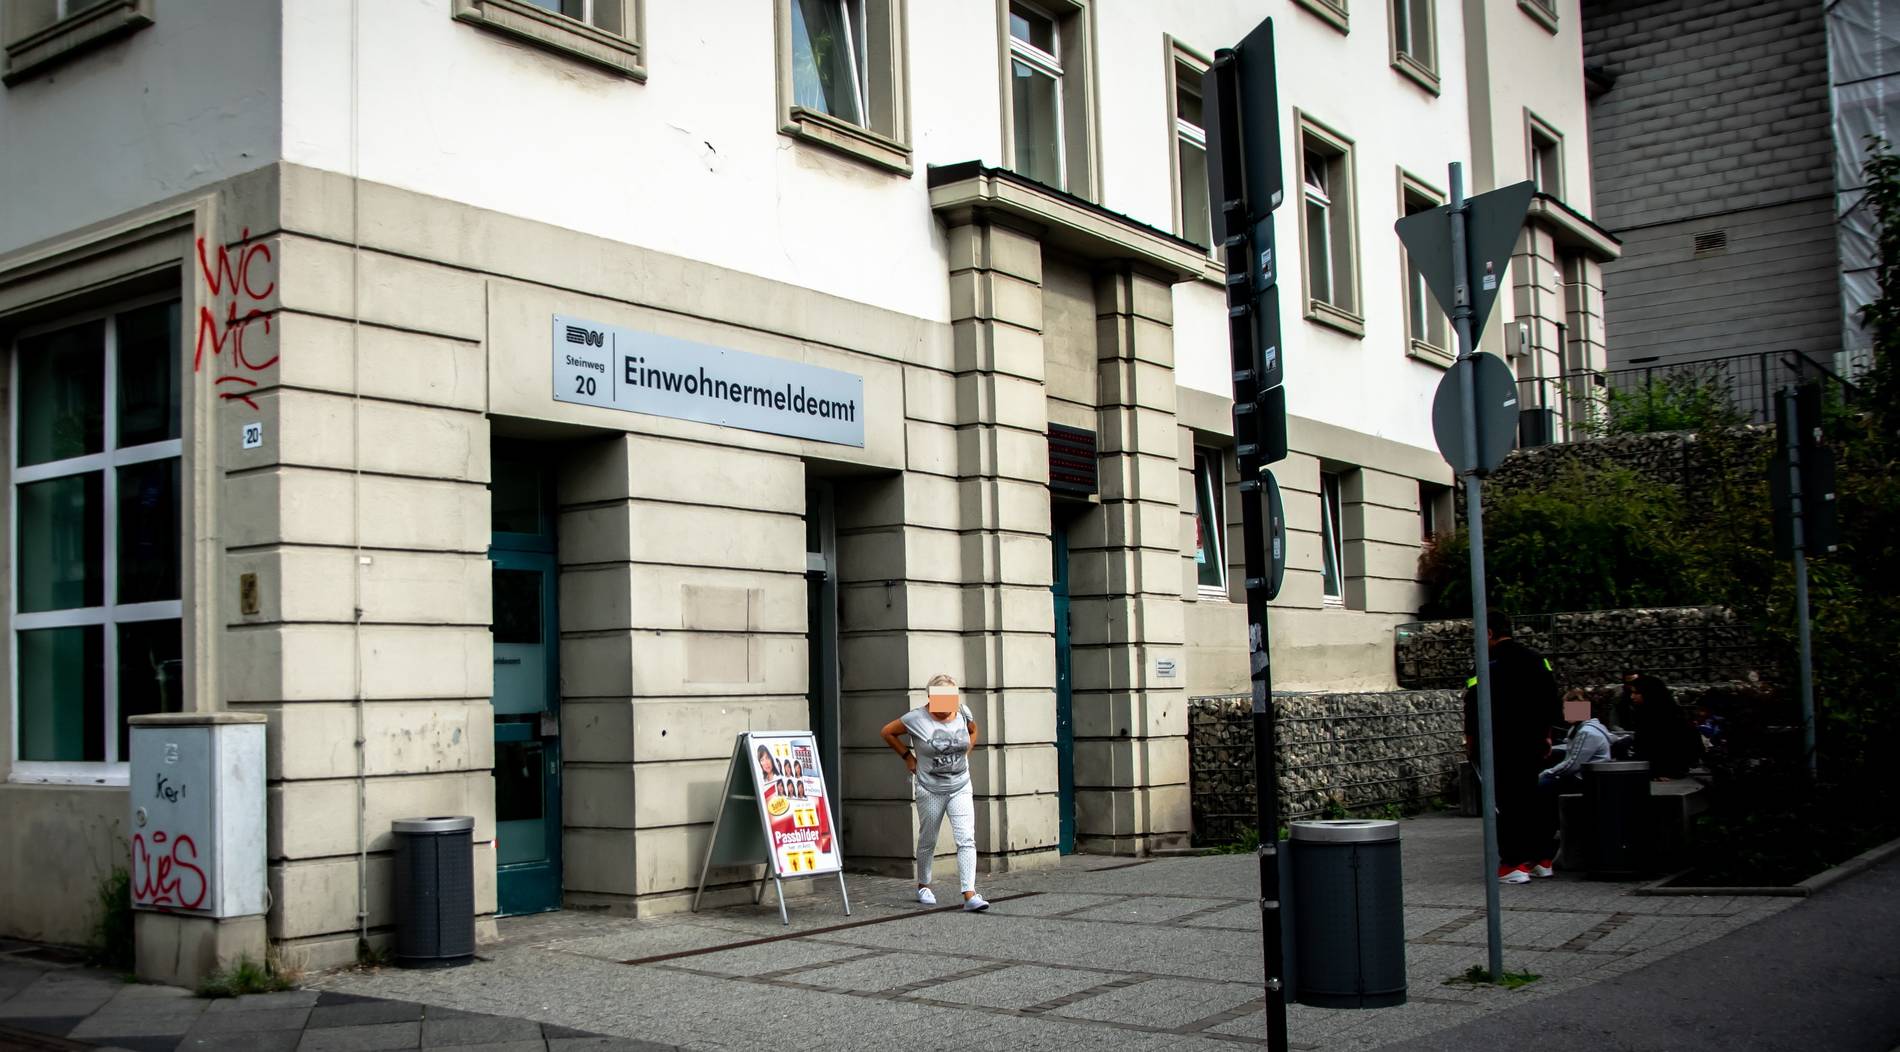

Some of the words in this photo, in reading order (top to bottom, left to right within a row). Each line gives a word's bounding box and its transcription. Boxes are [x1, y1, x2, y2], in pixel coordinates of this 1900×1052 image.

[566, 354, 605, 373] Steinweg
[575, 375, 597, 396] 20
[624, 355, 855, 422] Einwohnermeldeamt
[246, 427, 259, 444] 20
[775, 828, 819, 844] Passbilder
